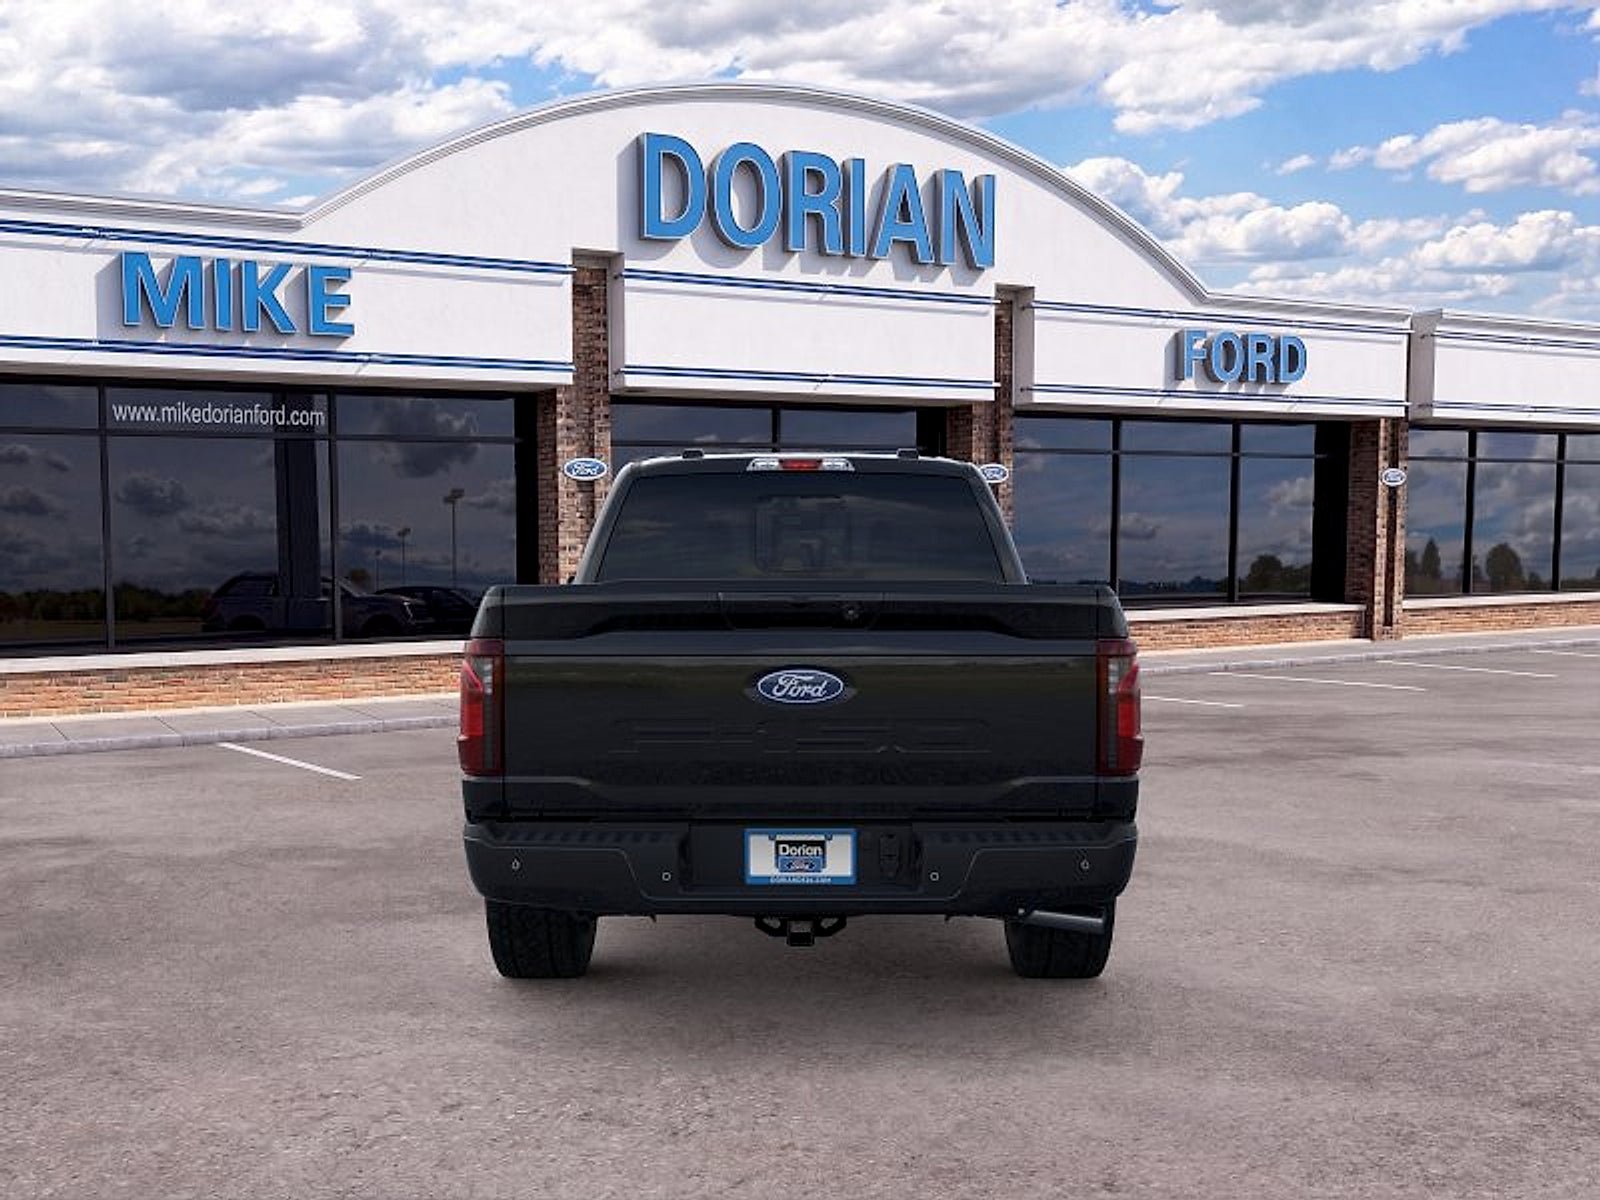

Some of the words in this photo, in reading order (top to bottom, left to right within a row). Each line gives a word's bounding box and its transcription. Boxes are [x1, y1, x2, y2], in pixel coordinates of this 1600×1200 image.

[640, 132, 996, 270] DORIAN
[121, 251, 355, 337] MIKE
[1183, 327, 1308, 384] FORD
[112, 401, 326, 426] www.mikedorianford.com
[772, 673, 828, 698] Ford
